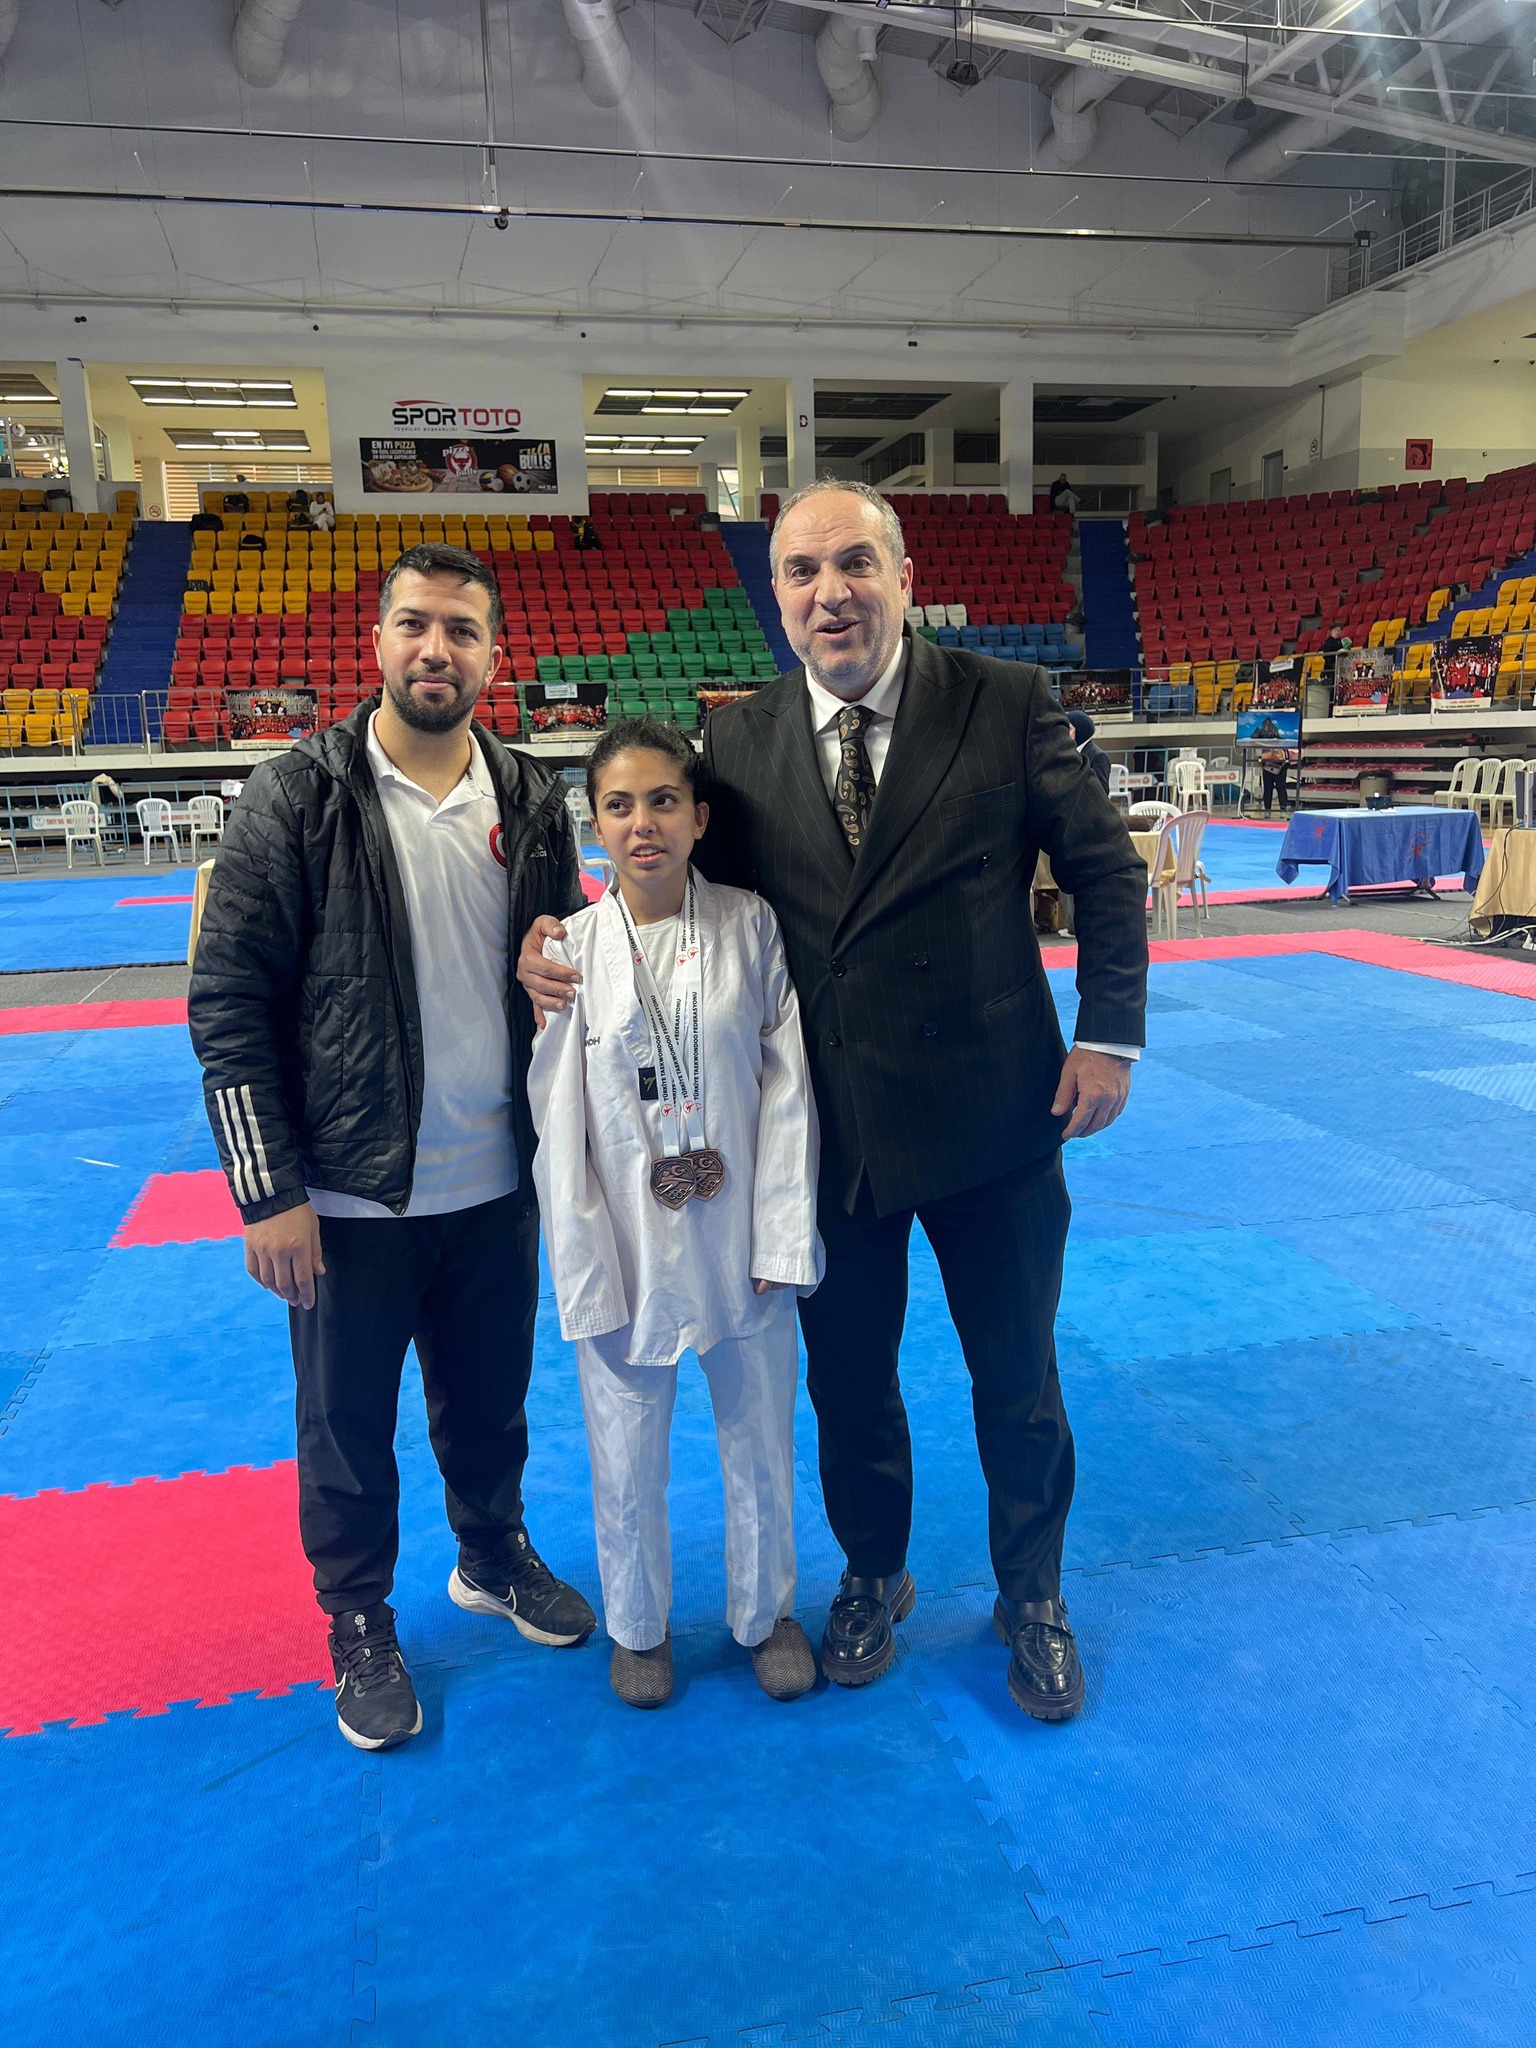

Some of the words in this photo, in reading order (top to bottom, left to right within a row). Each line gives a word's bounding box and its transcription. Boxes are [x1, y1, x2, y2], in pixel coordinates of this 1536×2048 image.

[442, 446, 469, 457] pizza
[519, 454, 552, 470] BULLS
[651, 995, 668, 1034] FEDERASYONU
[678, 1075, 688, 1099] TÜRKİYE
